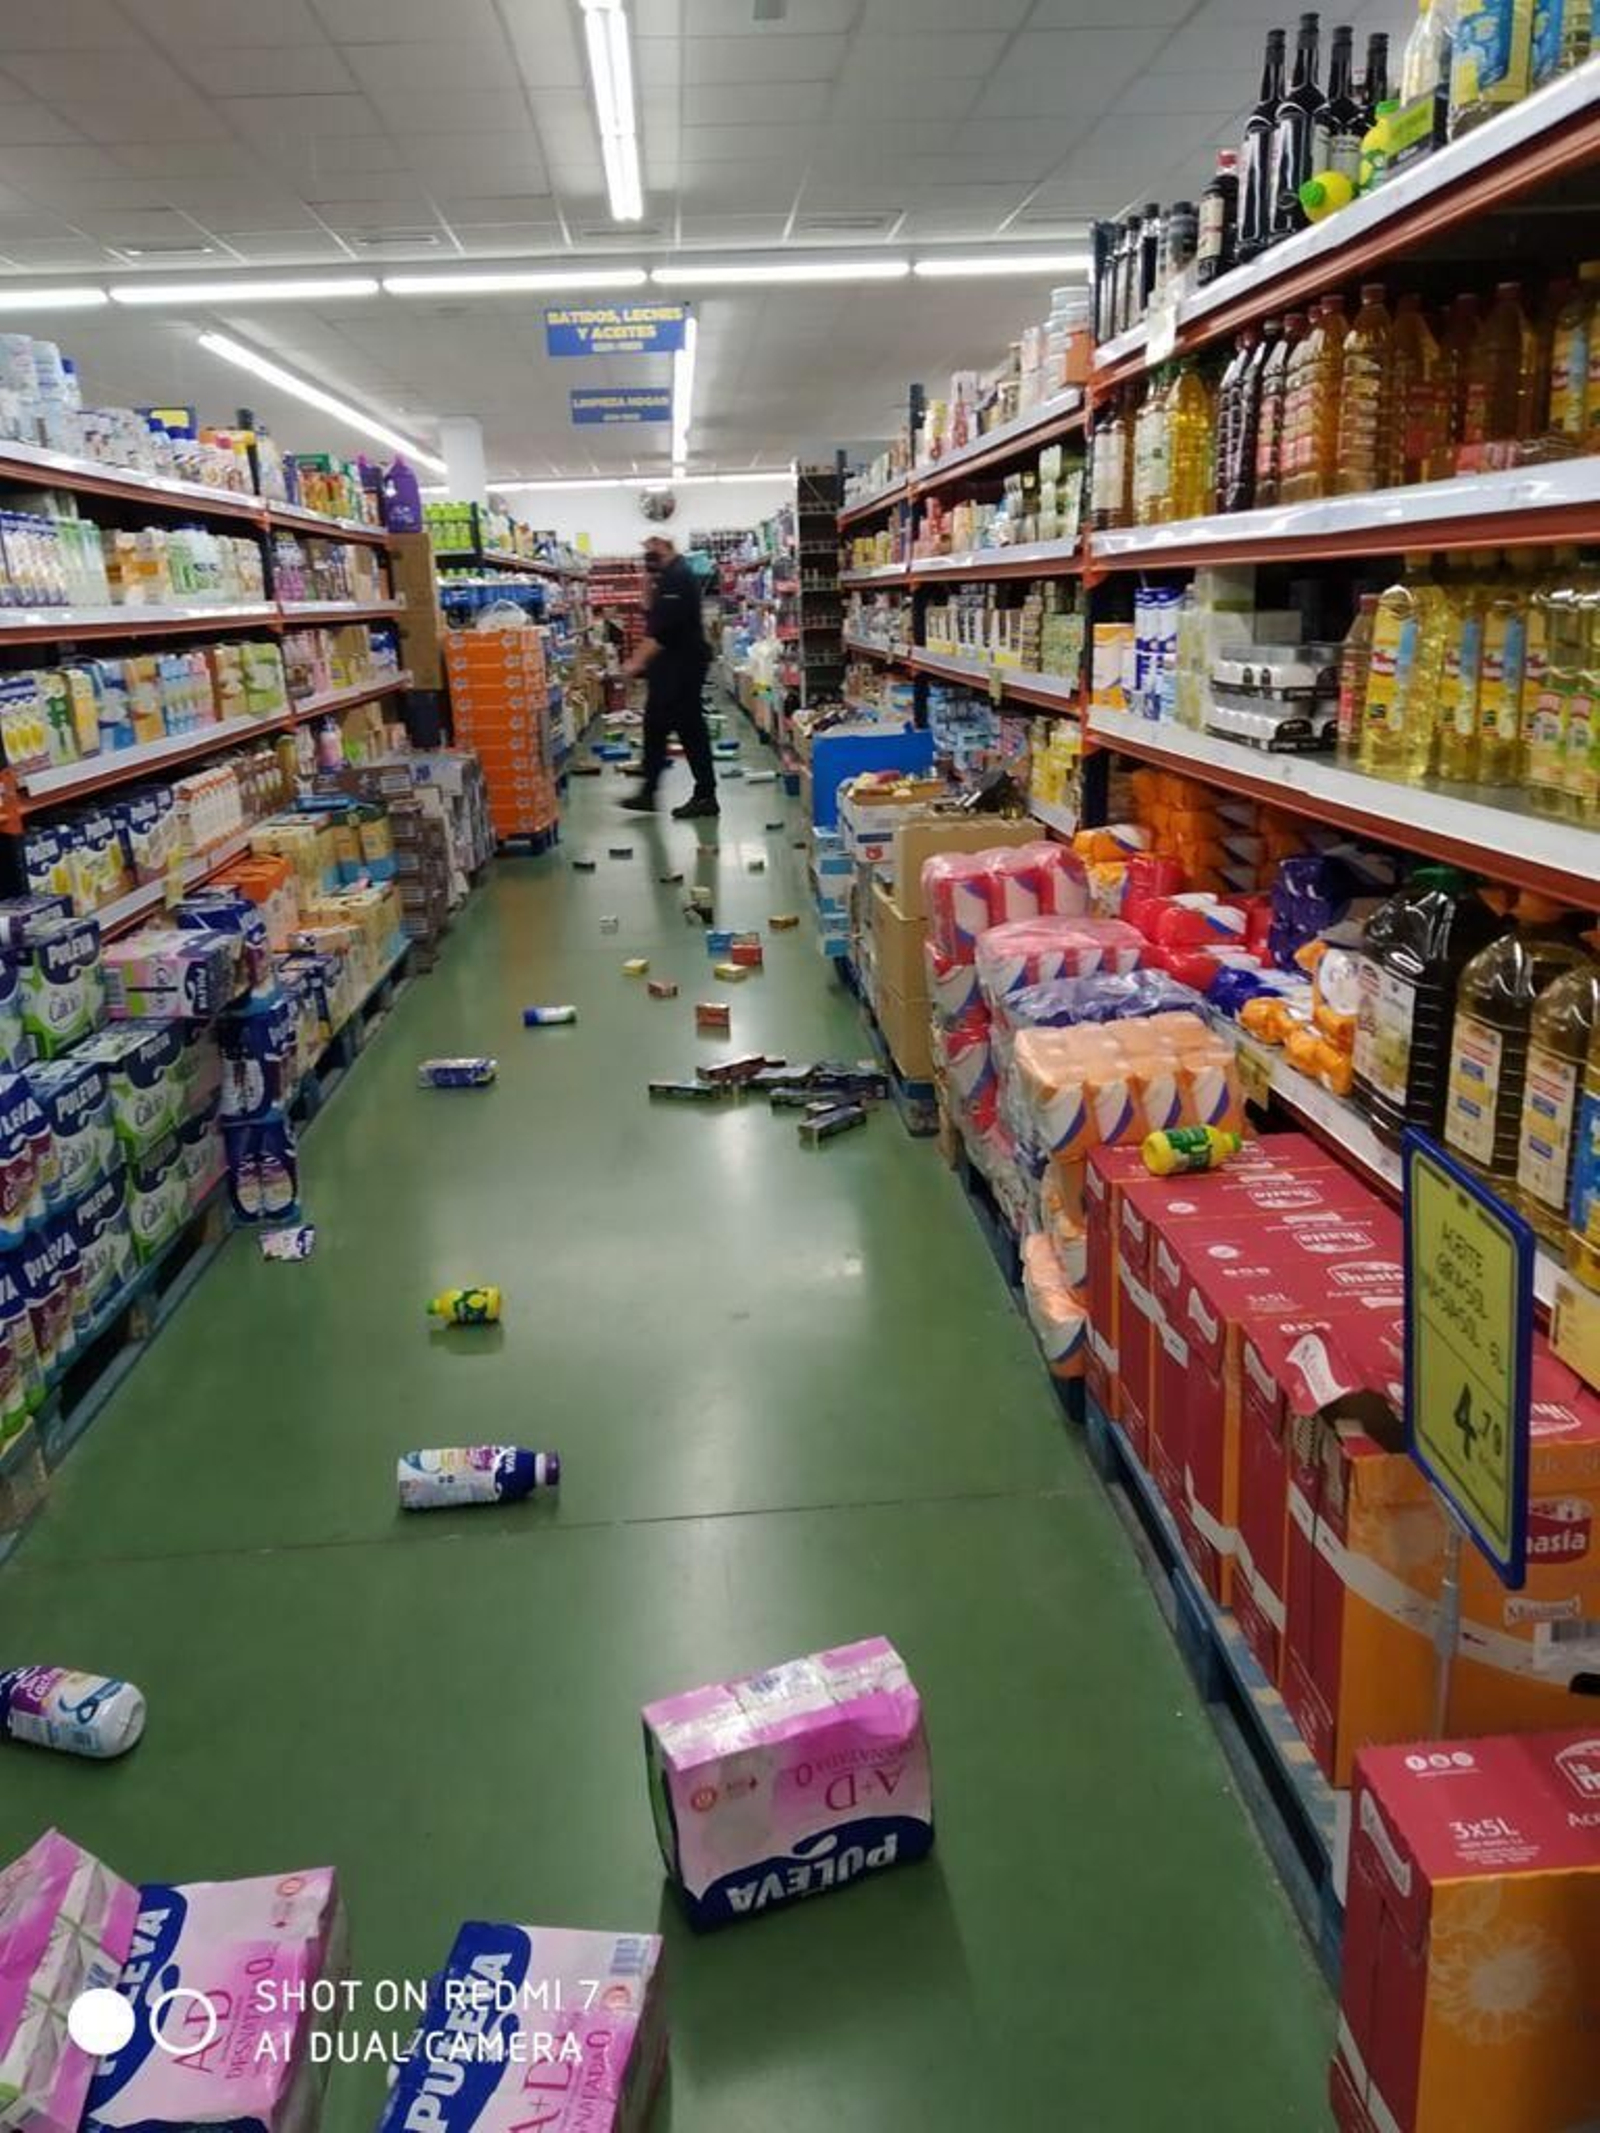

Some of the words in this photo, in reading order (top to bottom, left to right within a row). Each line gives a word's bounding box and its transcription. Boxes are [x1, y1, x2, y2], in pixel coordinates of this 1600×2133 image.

[0, 1097, 43, 1137] LEVA
[24, 1231, 78, 1288] PULEVA
[726, 1832, 899, 1913] PULEVA
